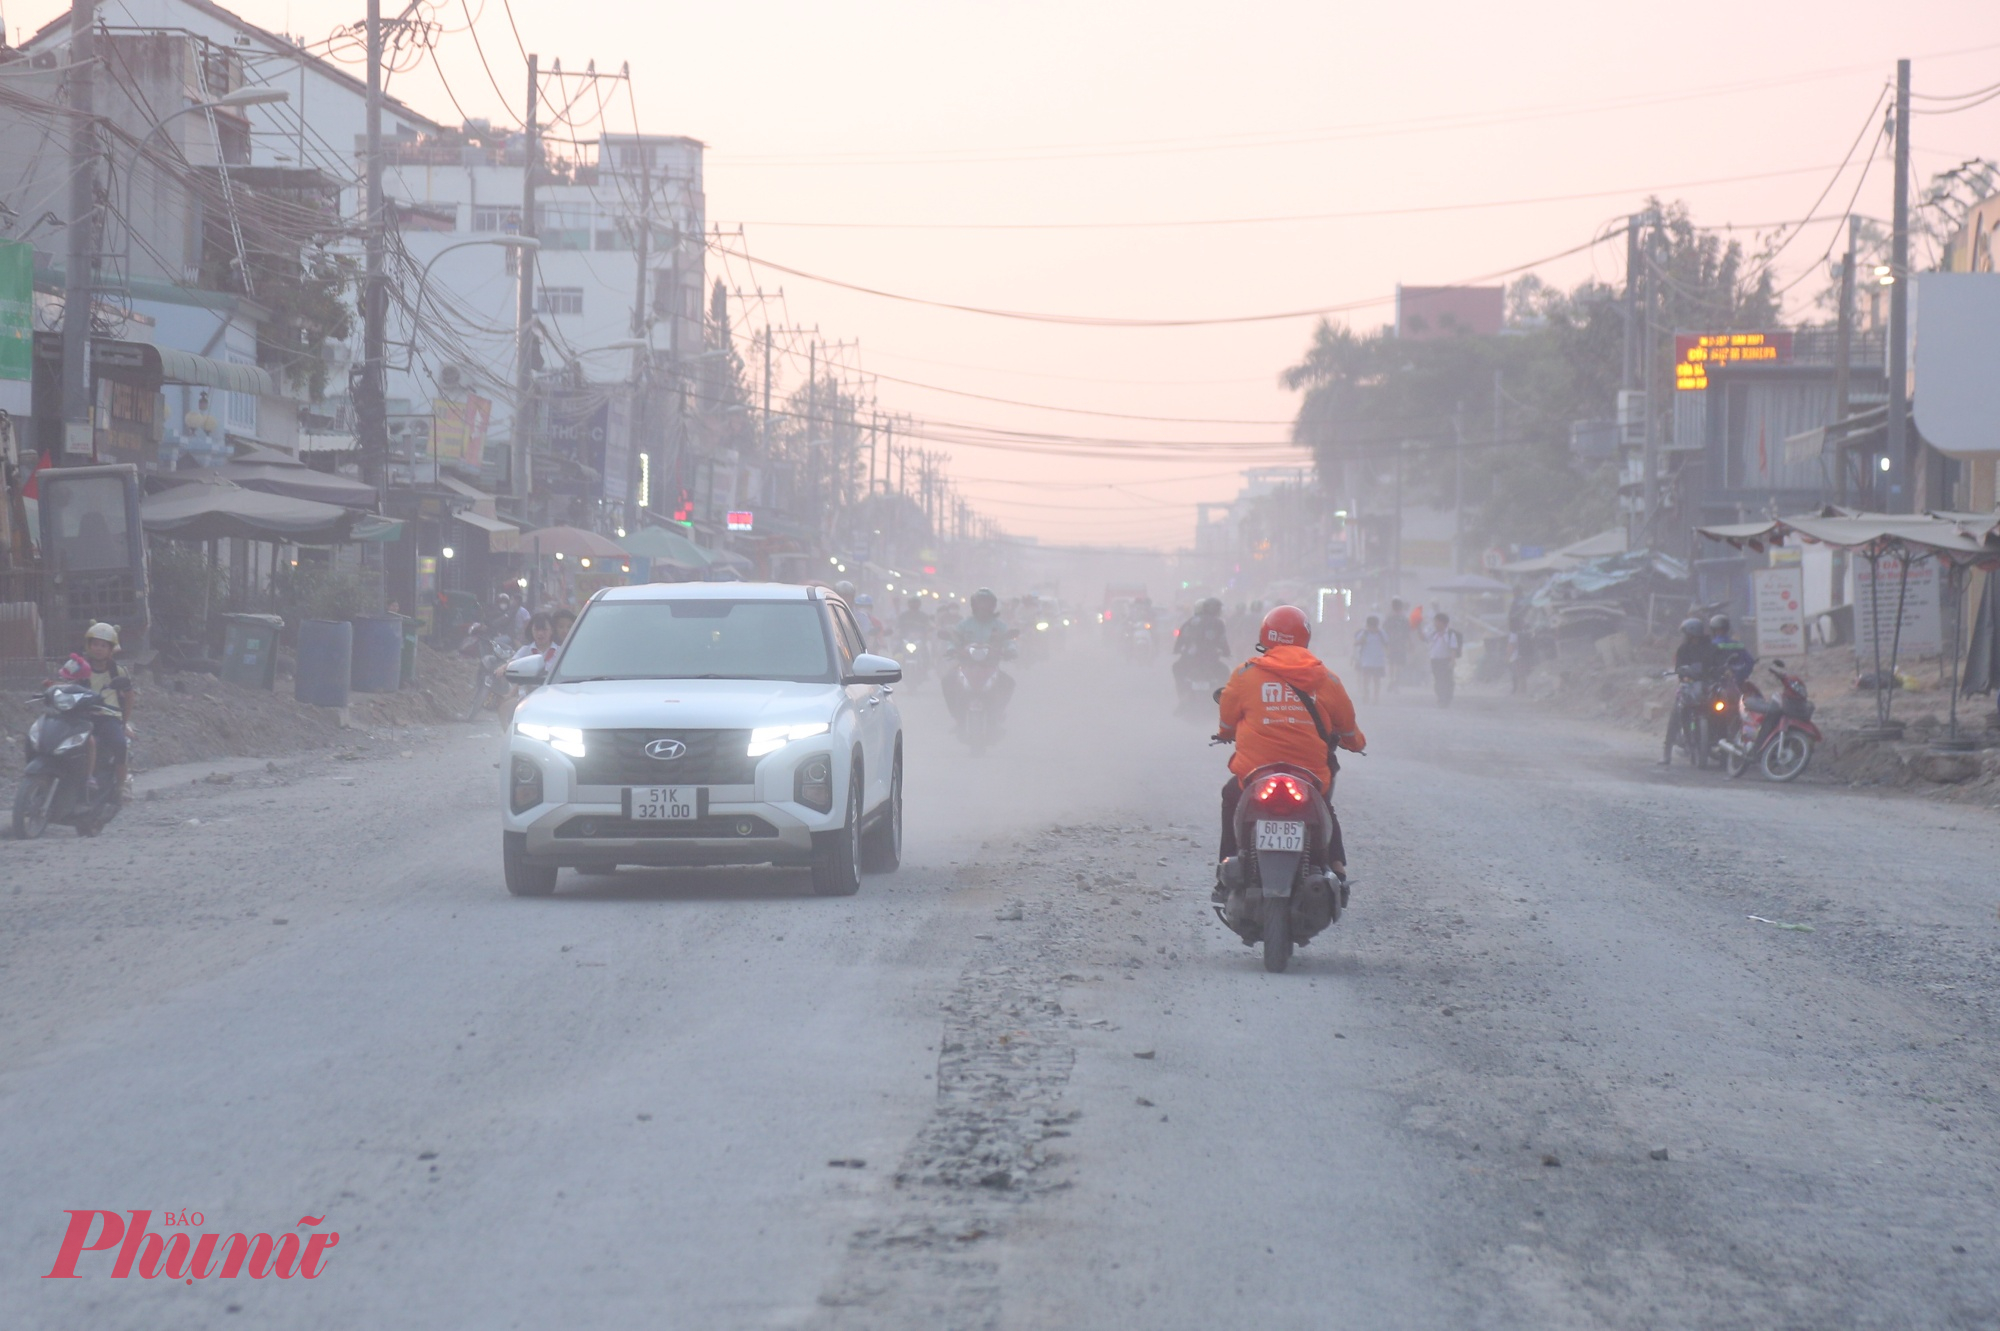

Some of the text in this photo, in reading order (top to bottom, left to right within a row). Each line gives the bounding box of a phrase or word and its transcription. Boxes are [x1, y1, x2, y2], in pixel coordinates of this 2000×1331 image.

[650, 789, 678, 802] 51K
[639, 804, 690, 818] 321.00
[1265, 822, 1297, 835] 60-B5
[1260, 836, 1301, 849] 741.07
